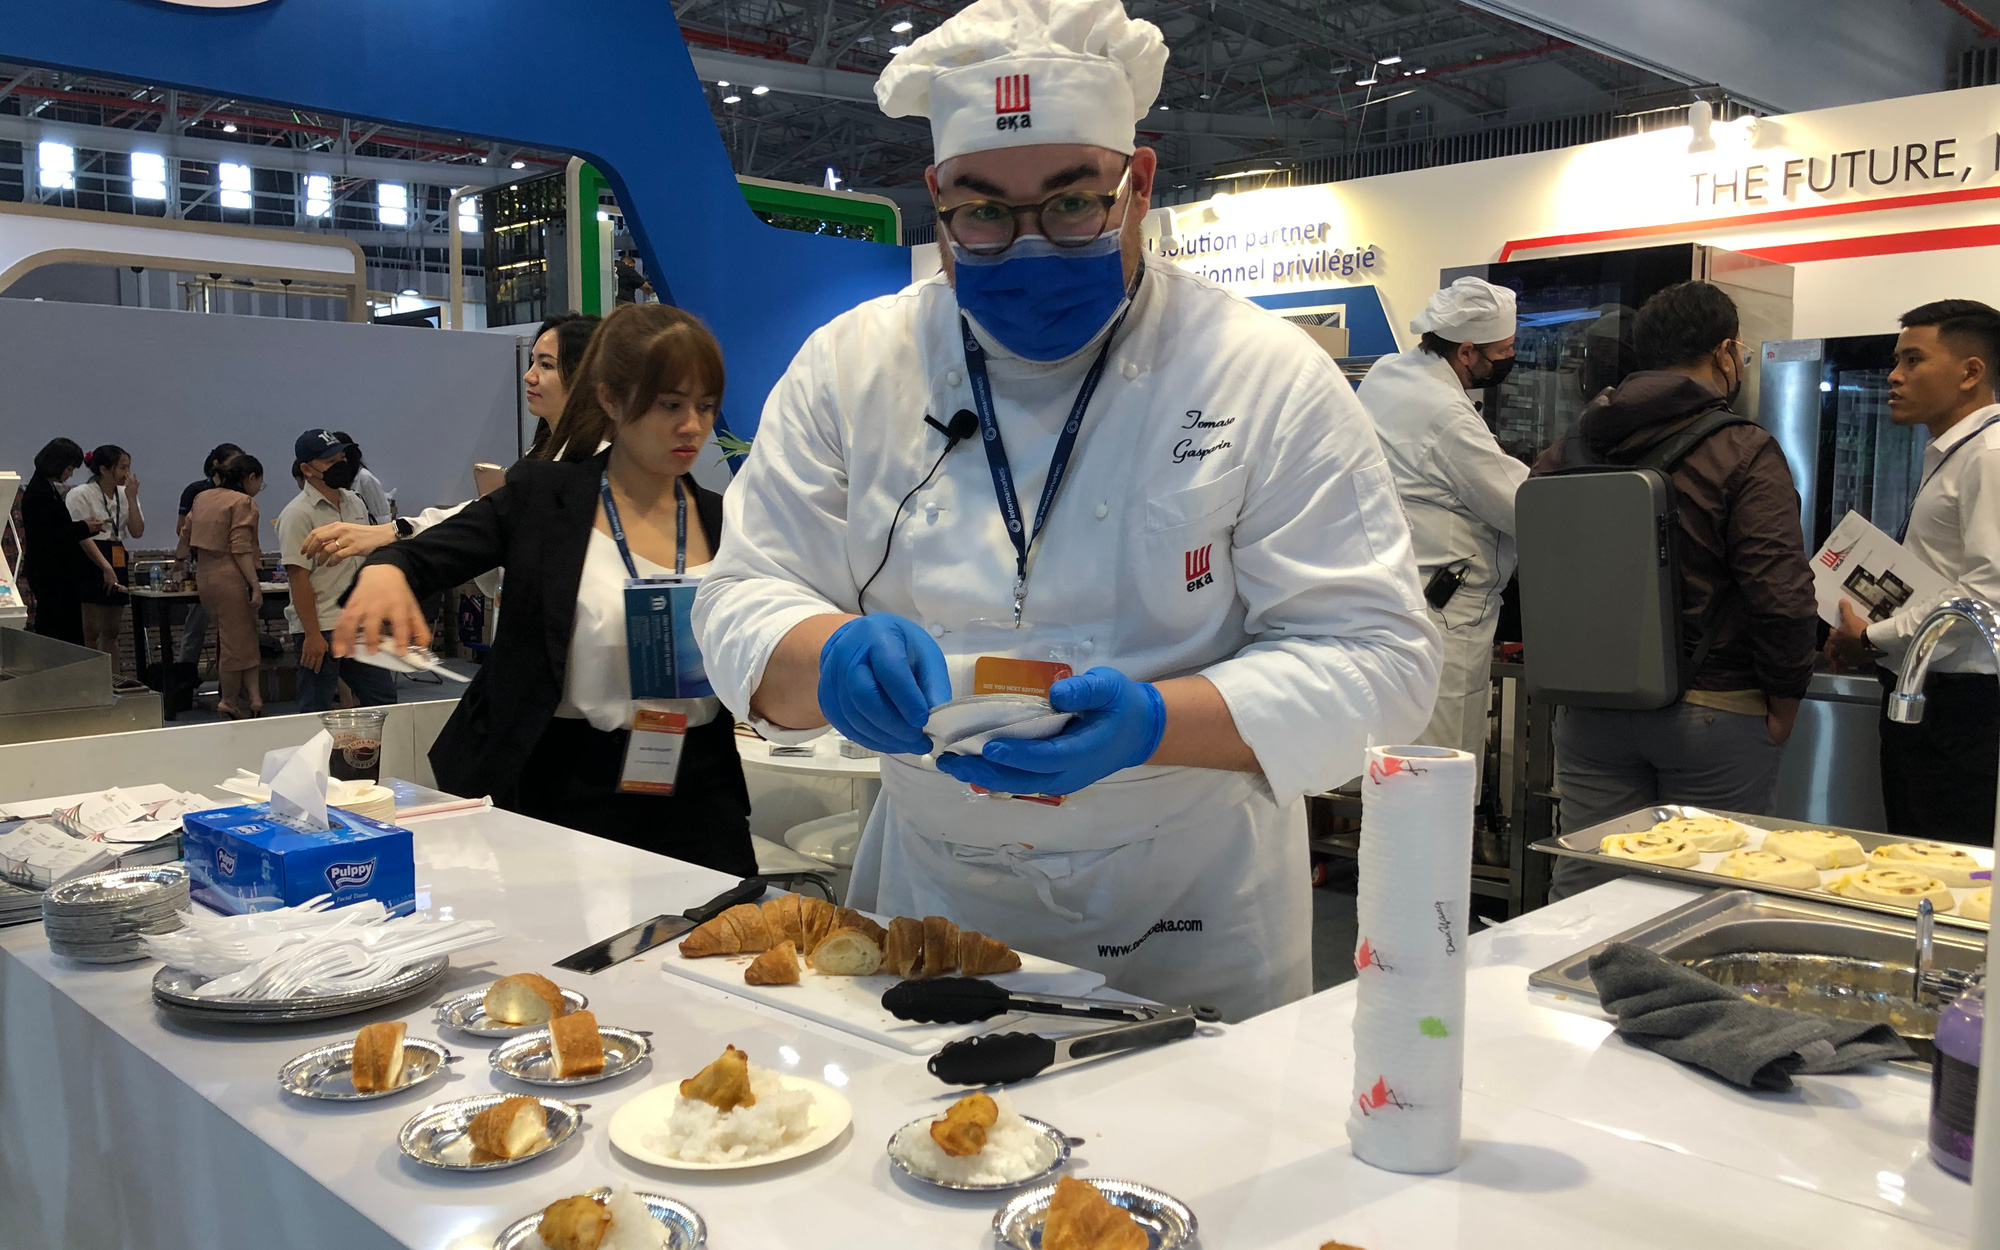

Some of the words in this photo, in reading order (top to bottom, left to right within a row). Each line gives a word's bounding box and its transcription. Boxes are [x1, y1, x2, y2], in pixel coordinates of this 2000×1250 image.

[1690, 165, 1764, 206] THE
[1782, 138, 1972, 196] FUTURE,
[1246, 222, 1326, 252] partner
[1273, 244, 1376, 284] privilégié
[1181, 409, 1236, 430] Tomaso
[1172, 438, 1233, 464] Gasparin
[1186, 571, 1214, 593] eka
[994, 683, 1006, 691] YOU
[331, 863, 373, 881] Pulppy
